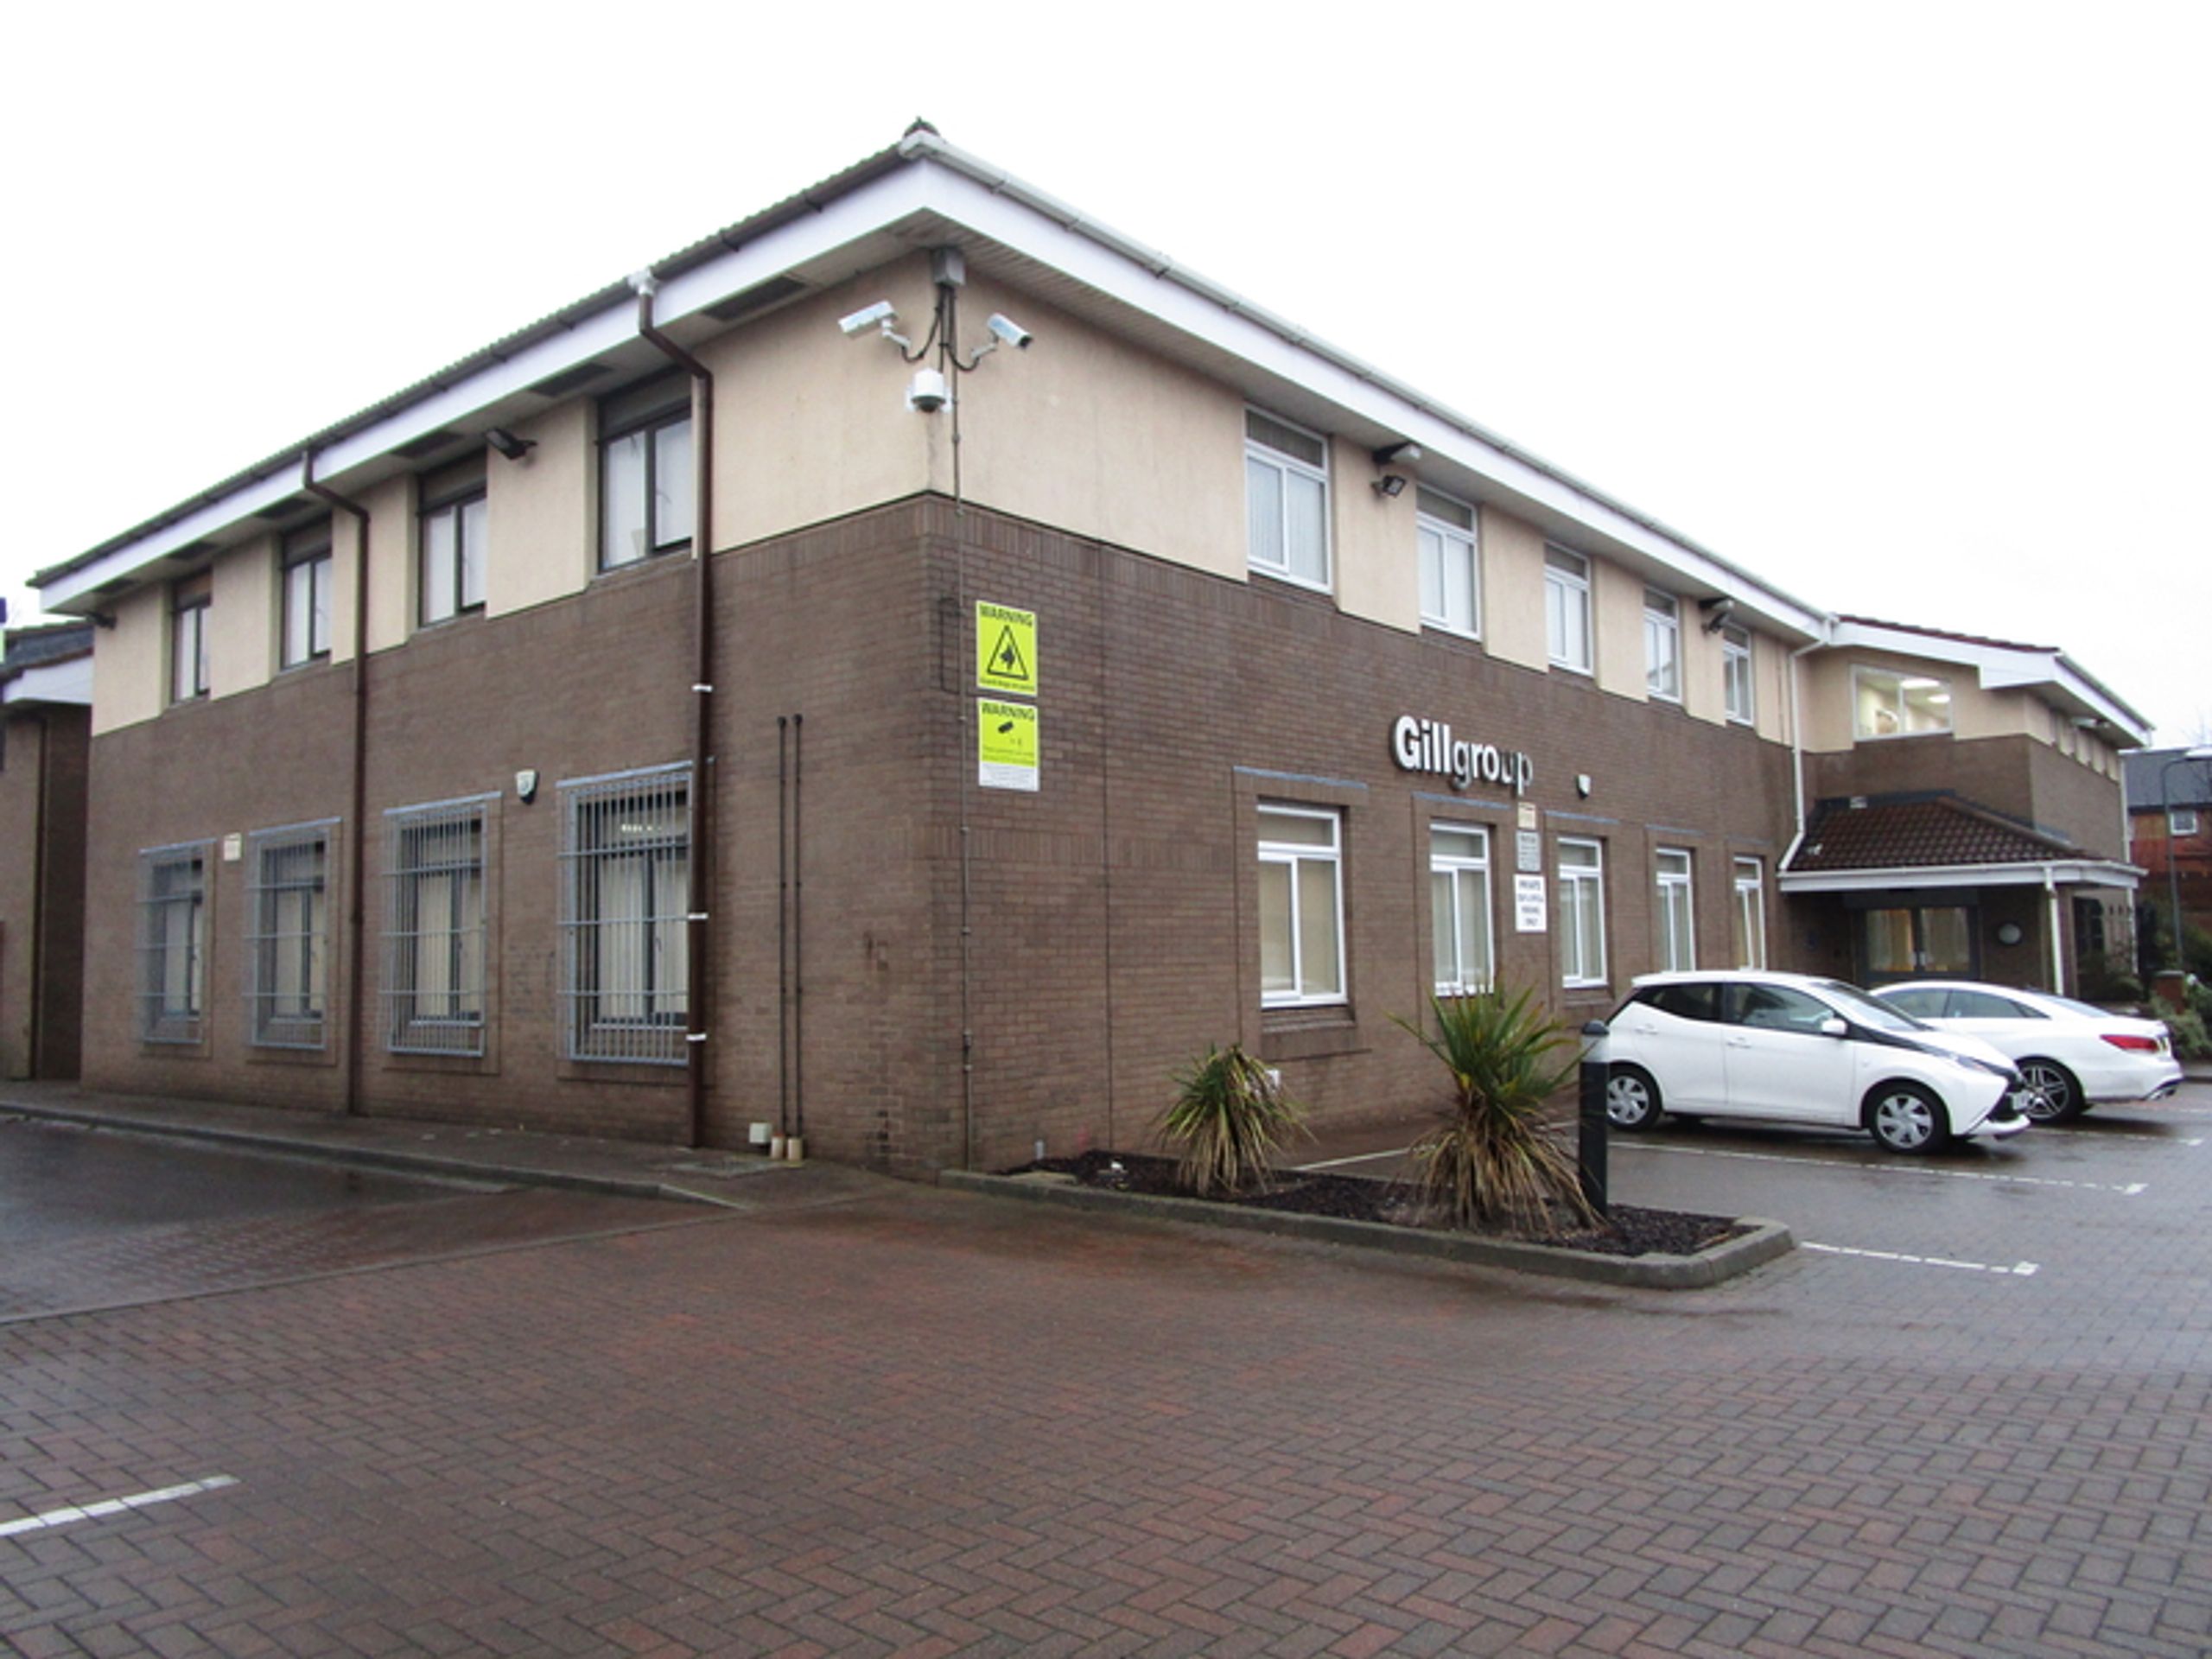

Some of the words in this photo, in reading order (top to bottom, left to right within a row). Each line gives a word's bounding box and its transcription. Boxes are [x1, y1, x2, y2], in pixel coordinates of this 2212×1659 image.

[980, 603, 1033, 628] WARNING
[982, 702, 1035, 721] WARNING
[1393, 715, 1534, 797] Gillgroup
